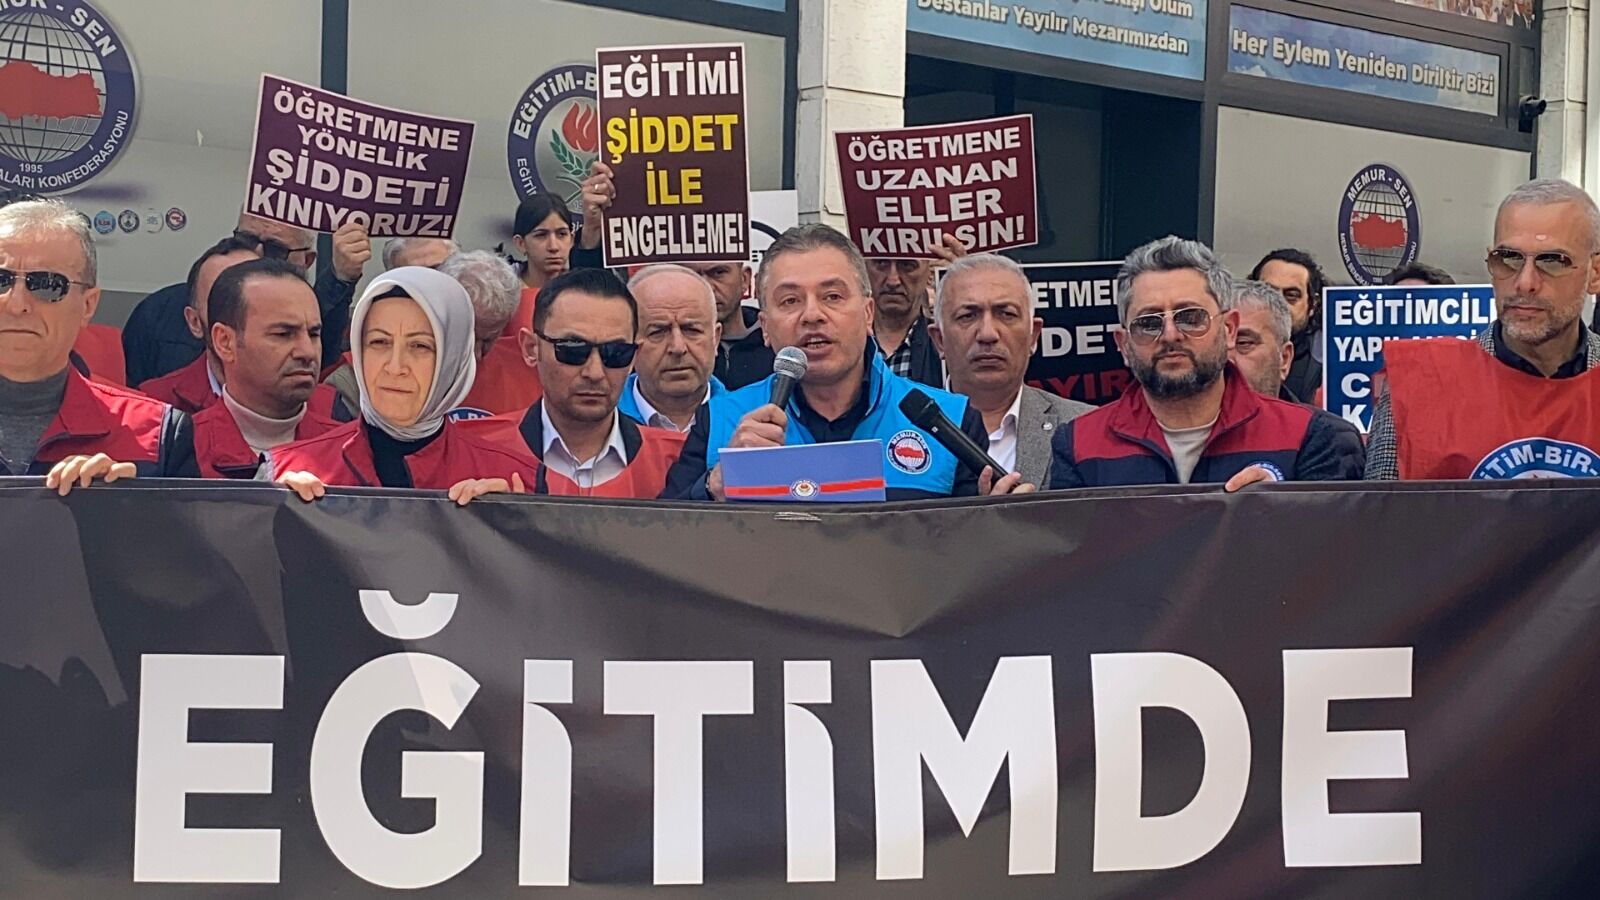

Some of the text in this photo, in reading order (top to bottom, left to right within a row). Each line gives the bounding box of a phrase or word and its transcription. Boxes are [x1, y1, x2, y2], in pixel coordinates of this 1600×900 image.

[1013, 5, 1068, 32] Yayılır
[1072, 16, 1188, 54] Mezarımızdan
[602, 51, 739, 98] EĞİTİMİ
[1232, 29, 1495, 96] Her Eylem Yeniden Diriltir Bizi
[273, 85, 461, 151] ÖĞRETMENE
[606, 108, 738, 164] ŞİDDET
[38, 110, 129, 188] KONFEDERASYONU
[297, 124, 428, 171] YÖNELİK
[848, 126, 1021, 162] ÖĞRETMENE
[19, 163, 43, 173] 1995
[265, 148, 450, 207] ŞİDDETİ
[646, 161, 703, 205] İLE
[856, 157, 1018, 191] UZANAN
[251, 183, 453, 237] KINIYORUZ!
[875, 188, 1003, 223] ELLER
[608, 213, 744, 258] ENGELLEME!
[1031, 279, 1119, 309] ETME
[133, 589, 1422, 889] EĞİTİMDE
